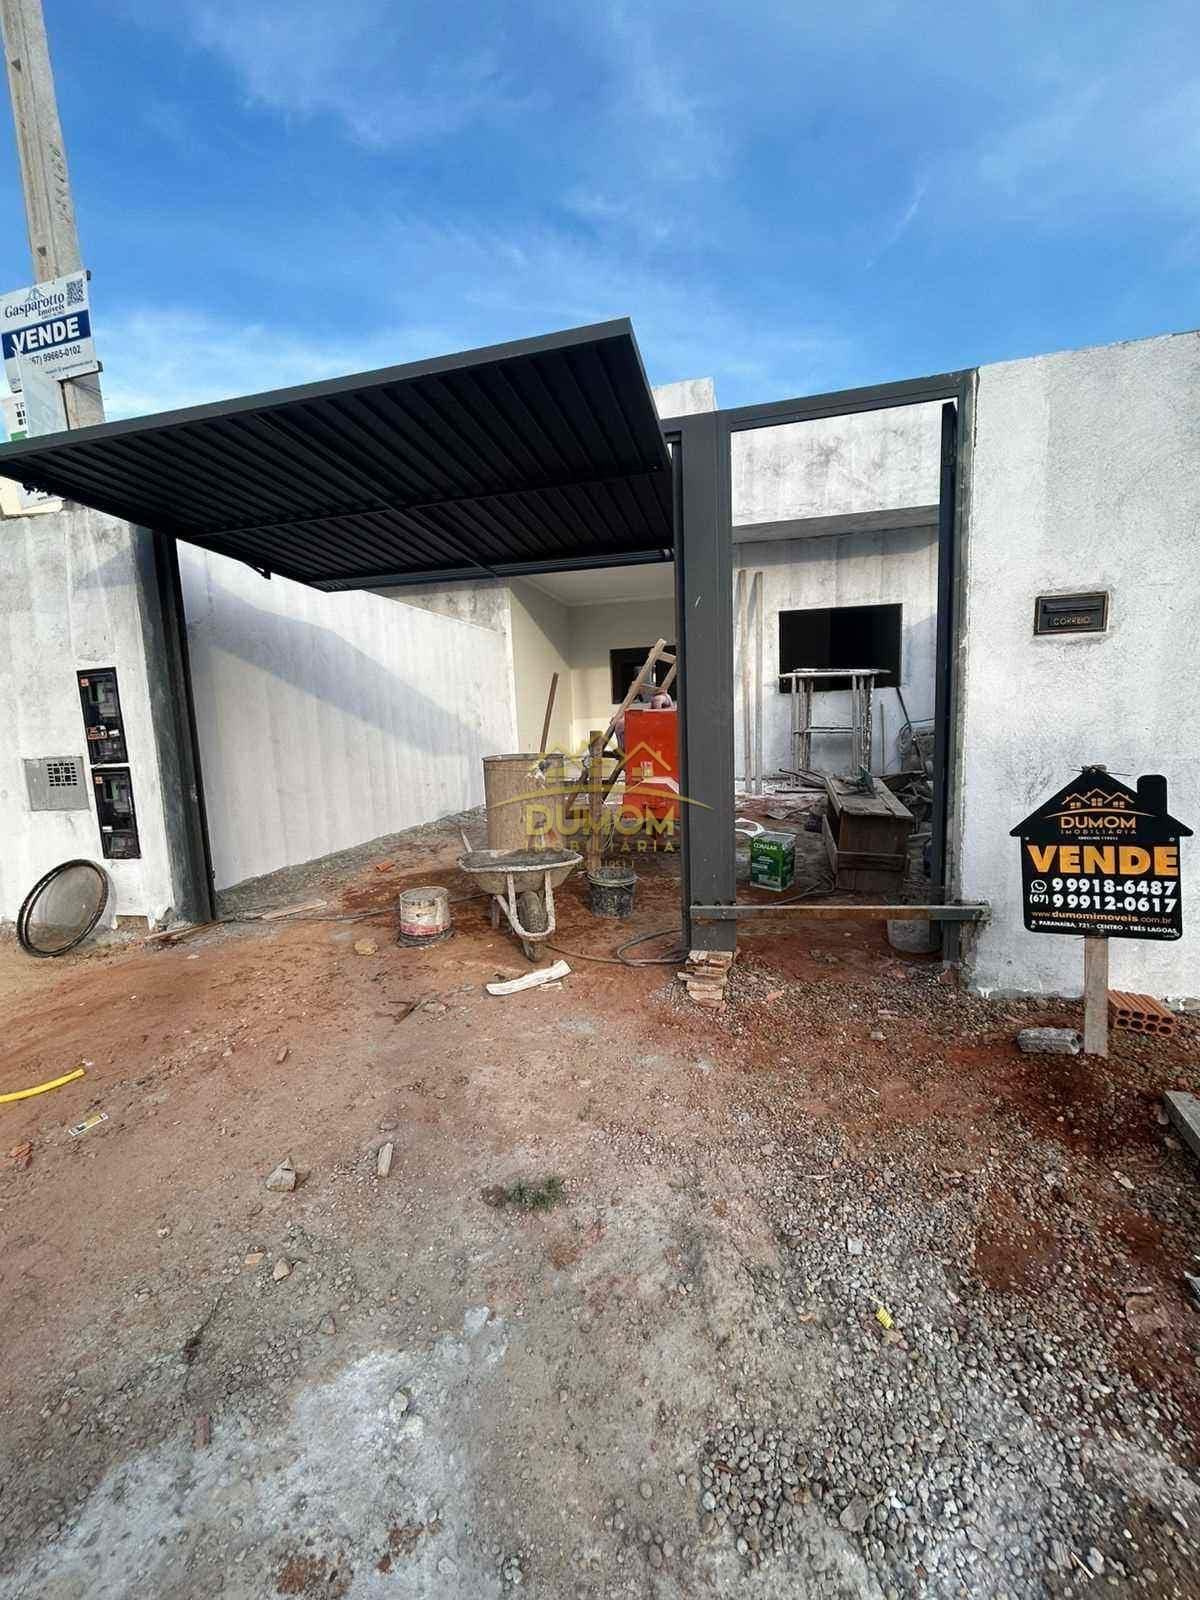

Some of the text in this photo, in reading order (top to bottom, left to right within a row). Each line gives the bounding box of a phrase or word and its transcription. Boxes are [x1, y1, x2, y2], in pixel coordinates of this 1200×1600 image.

[4, 293, 65, 319] Gasparotto
[11, 316, 80, 352] VENDE
[1061, 816, 1137, 829] DUMOM
[1026, 844, 1179, 877] VENDE
[1029, 894, 1049, 905] (67)
[1031, 911, 1173, 925] www.dumomimoveis.com.br
[1147, 926, 1177, 934] LAGOAS
